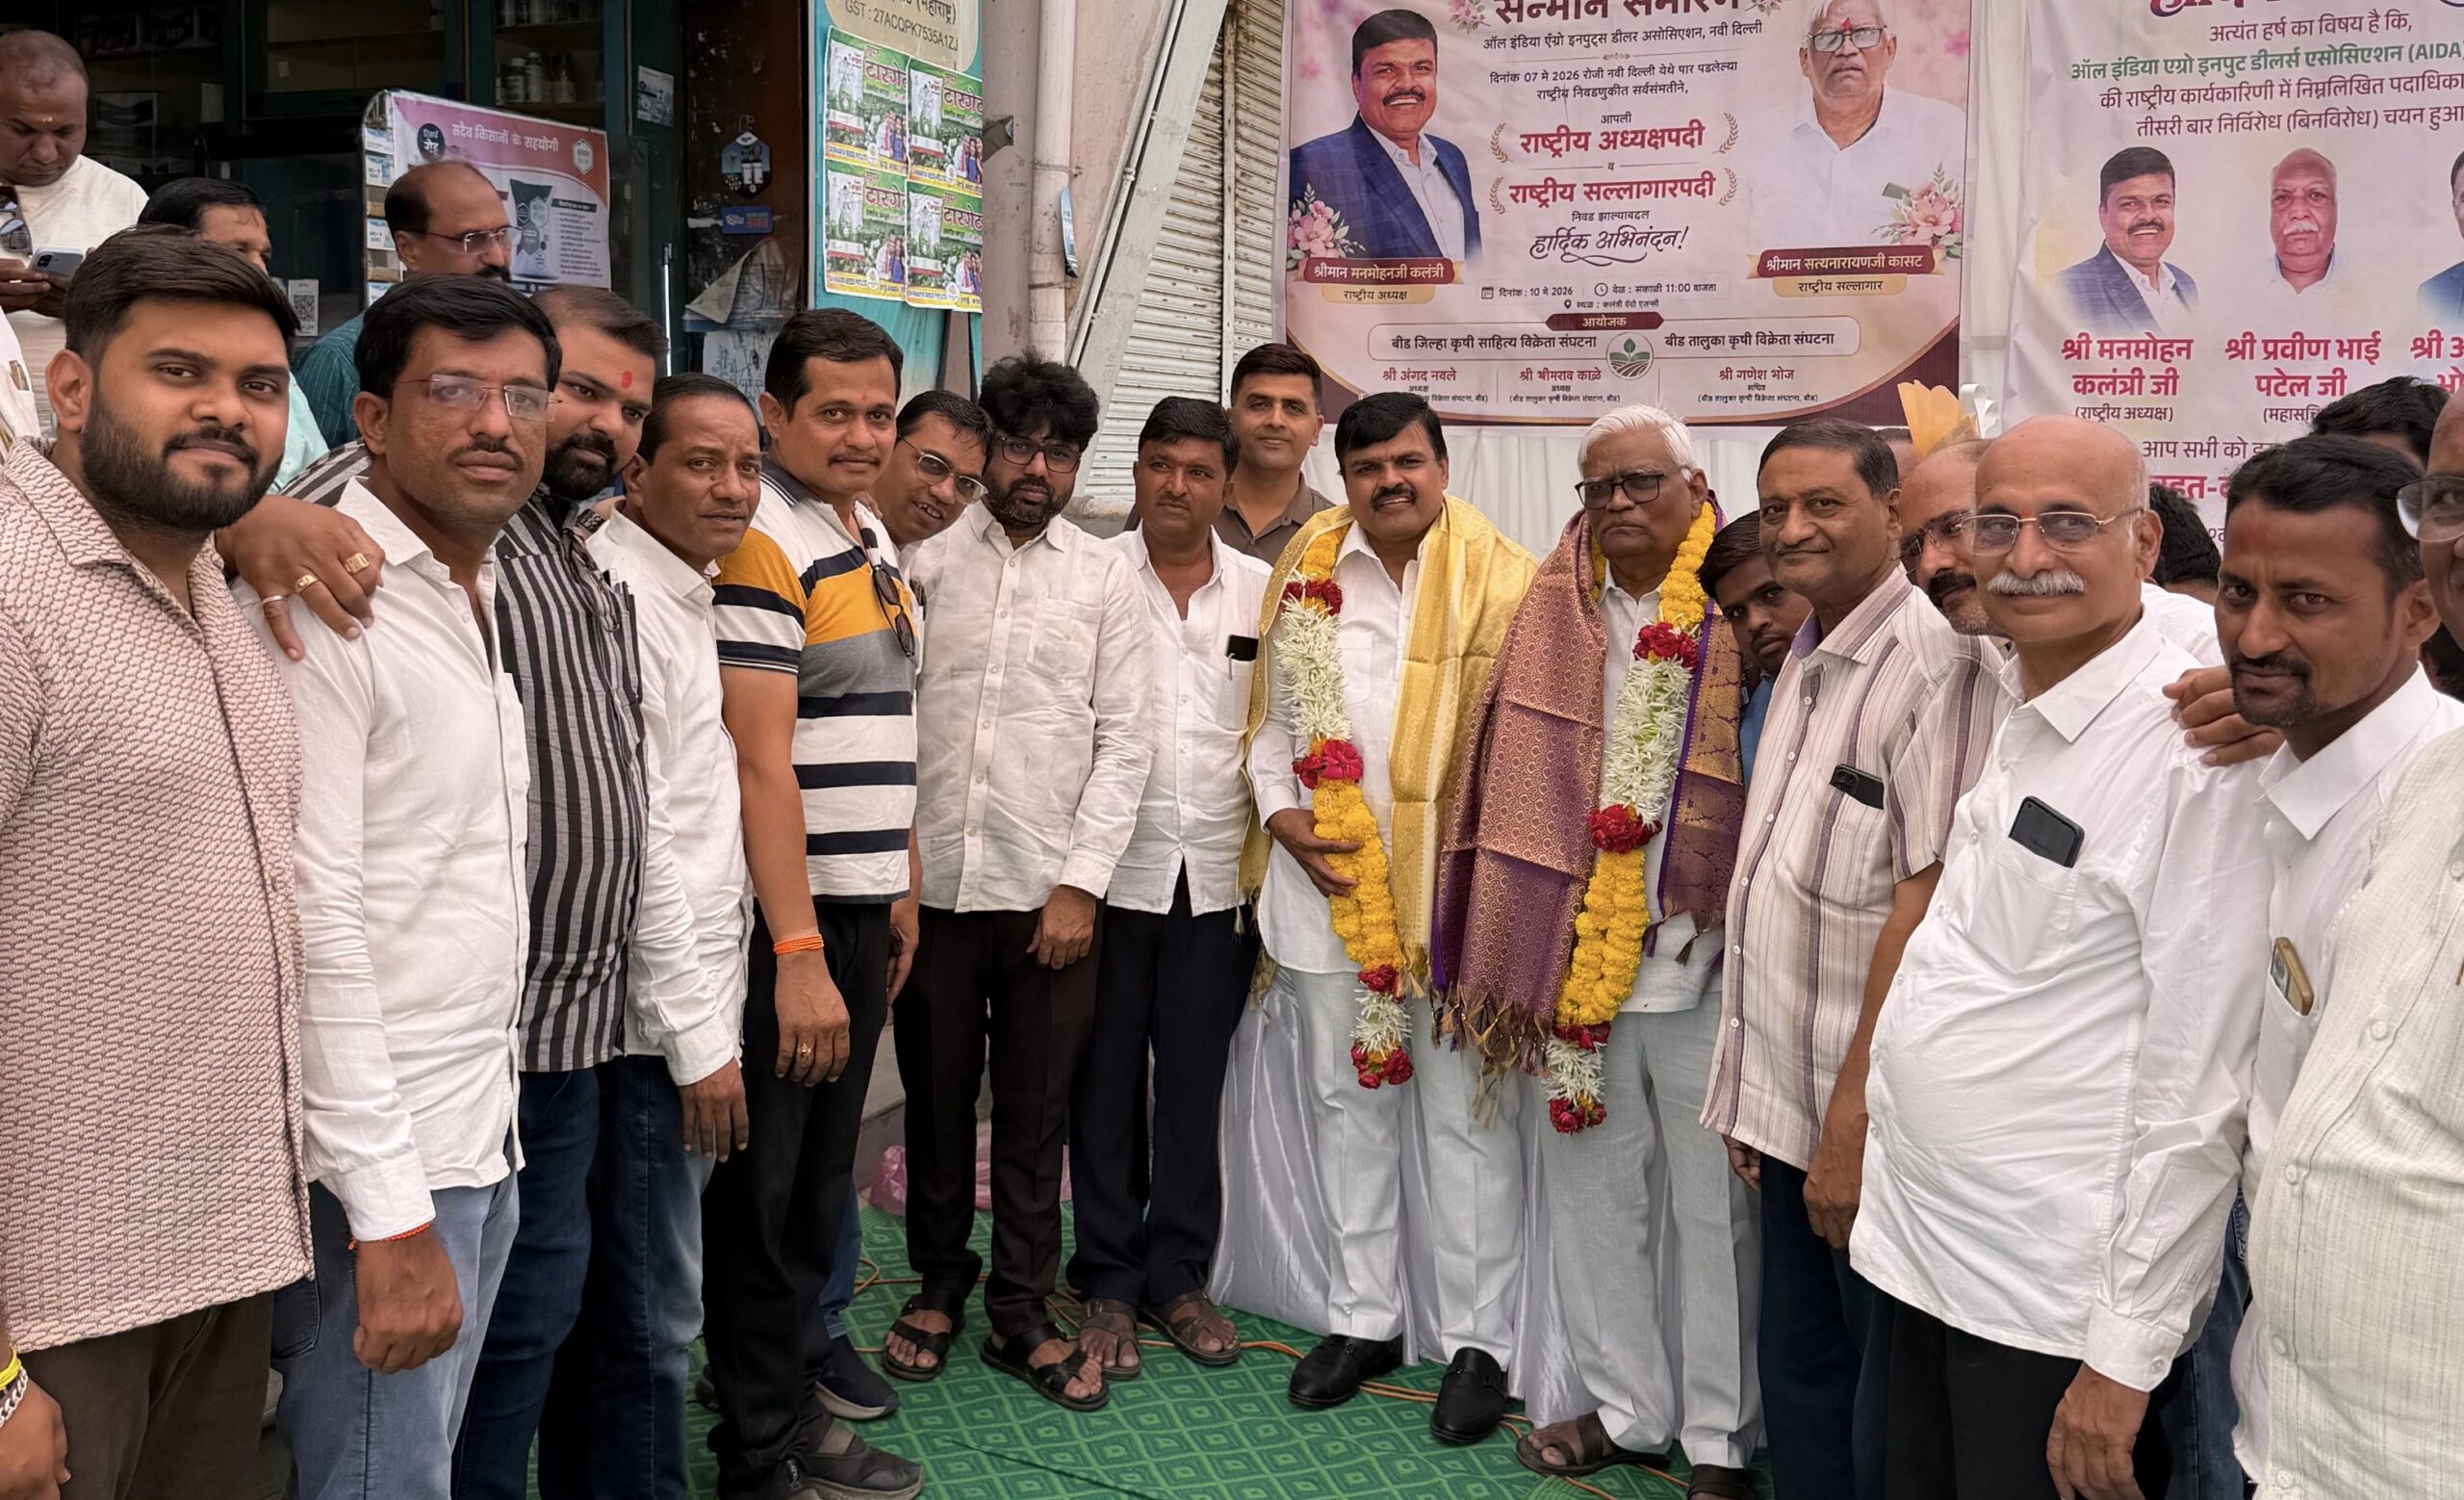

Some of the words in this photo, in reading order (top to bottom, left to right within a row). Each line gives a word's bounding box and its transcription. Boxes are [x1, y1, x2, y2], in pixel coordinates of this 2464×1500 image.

[845, 1, 866, 21] GST
[1482, 38, 1506, 50] ऑल
[1510, 34, 1541, 50] इंडिया
[1568, 34, 1607, 49] इनपुट्स
[1611, 29, 1638, 43] डीलर
[1642, 25, 1706, 43] असोसिएशन,
[1709, 22, 1729, 38] नवी
[1732, 19, 1762, 36] दिल्ली
[2209, 20, 2258, 41] अत्यंत
[2263, 16, 2287, 40] हर्ष
[2291, 19, 2315, 37] का
[2319, 13, 2364, 36] विषय
[2368, 9, 2381, 34] है
[2385, 9, 2413, 33] कि,
[1490, 69, 1520, 85] दिनांक
[1524, 72, 1538, 82] 07
[1541, 69, 1549, 82] मे
[1553, 70, 1579, 81] 2026
[1583, 65, 1604, 80] रोजी
[1607, 65, 1625, 78] नवी
[1628, 63, 1656, 78] दिल्ली
[1658, 62, 1675, 76] येथे
[1679, 64, 1695, 76] पार
[1698, 60, 1738, 74] पडलेल्या
[2071, 59, 2108, 80] ऑल
[2111, 56, 2160, 82] इंडिया
[2163, 53, 2194, 74] एग्रो
[2197, 55, 2247, 78] इनपुट
[2250, 47, 2300, 70] डीलर्स
[2304, 43, 2404, 67] एसोसिएशन
[1536, 87, 1569, 103] राष्ट्रीय
[1573, 84, 1629, 101] निवडणुकीत
[1632, 81, 1689, 96] सर्वसंमतीने,
[2099, 87, 2123, 109] की
[2126, 84, 2176, 111] राष्ट्रीय
[2180, 79, 2274, 105] कार्यकारिणी
[2278, 78, 2292, 99] में
[2297, 74, 2385, 100] निम्नलिखित
[2390, 69, 2464, 94] पदाधिका
[1601, 111, 1632, 124] आपली
[2136, 114, 2183, 138] तीसरी
[2187, 117, 2214, 135] बार
[2218, 109, 2282, 133] निर्विरोध
[2287, 106, 2378, 133] (बिनविरोध)
[2383, 107, 2426, 126] चयन
[2429, 105, 2464, 131] हुआ
[1520, 123, 1592, 159] राष्ट्रीय
[1598, 117, 1706, 151] अध्यक्षपदी
[1607, 163, 1615, 171] व
[1509, 176, 1577, 208] राष्ट्रीय
[1583, 169, 1716, 202] सल्लागारपदी
[1572, 210, 1594, 222] निवड
[1529, 226, 1592, 262] हार्दिक
[1595, 224, 1690, 253] अभिनंदन!
[1314, 262, 1348, 279] श्रीमान
[1350, 263, 1407, 281] मनमोहनजी
[1410, 263, 1445, 278] कलंत्री
[1766, 256, 1802, 272] श्रीमान
[1804, 253, 1886, 271] सत्यनारायणजी
[1887, 254, 1923, 269] कासट
[1344, 289, 1374, 302] राष्ट्रीय
[1377, 290, 1408, 300] अध्यक्ष
[1530, 287, 1540, 297] 10
[1552, 287, 1573, 297] 2026
[1665, 283, 1691, 293] 11:00
[1798, 278, 1833, 295] राष्ट्रीय
[1835, 278, 1884, 292] सल्लागार
[1581, 315, 1628, 328] आयोजक
[1391, 334, 1411, 350] बीड
[1414, 334, 1448, 351] जिल्हा
[1450, 335, 1475, 352] कृषी
[1478, 333, 1518, 350] साहित्य
[1521, 333, 1556, 349] विक्रेता
[1558, 332, 1597, 349] संघटना
[1664, 332, 1685, 348] बीड
[1687, 334, 1726, 350] तालुका
[1729, 332, 1752, 350] कृषी
[1755, 332, 1791, 347] विक्रेता
[1793, 330, 1835, 346] संघटना
[2061, 332, 2092, 361] श्री
[2096, 332, 2194, 363] मनमोहन
[2224, 330, 2257, 361] श्री
[2261, 330, 2331, 361] प्रवीण
[2336, 329, 2382, 366] भाई
[2410, 328, 2445, 360] श्री
[1382, 367, 1397, 381] श्री
[1400, 367, 1428, 381] अंगद
[1520, 367, 1533, 381] श्री
[1577, 366, 1603, 381] काळे
[1719, 367, 1733, 381] श्री
[1736, 365, 1768, 380] गणेश
[1771, 365, 1795, 380] भोज
[2072, 367, 2145, 396] कलंत्री
[2150, 367, 2180, 396] जी
[2255, 367, 2312, 397] पटेल
[2316, 367, 2348, 397] जी
[2075, 403, 2120, 423] (राष्ट्रीय
[2123, 405, 2173, 422] अध्यक्ष)
[2263, 404, 2323, 424] (महासचि
[2143, 440, 2179, 458] आप
[2182, 436, 2219, 459] सभी
[2222, 436, 2247, 459] को
